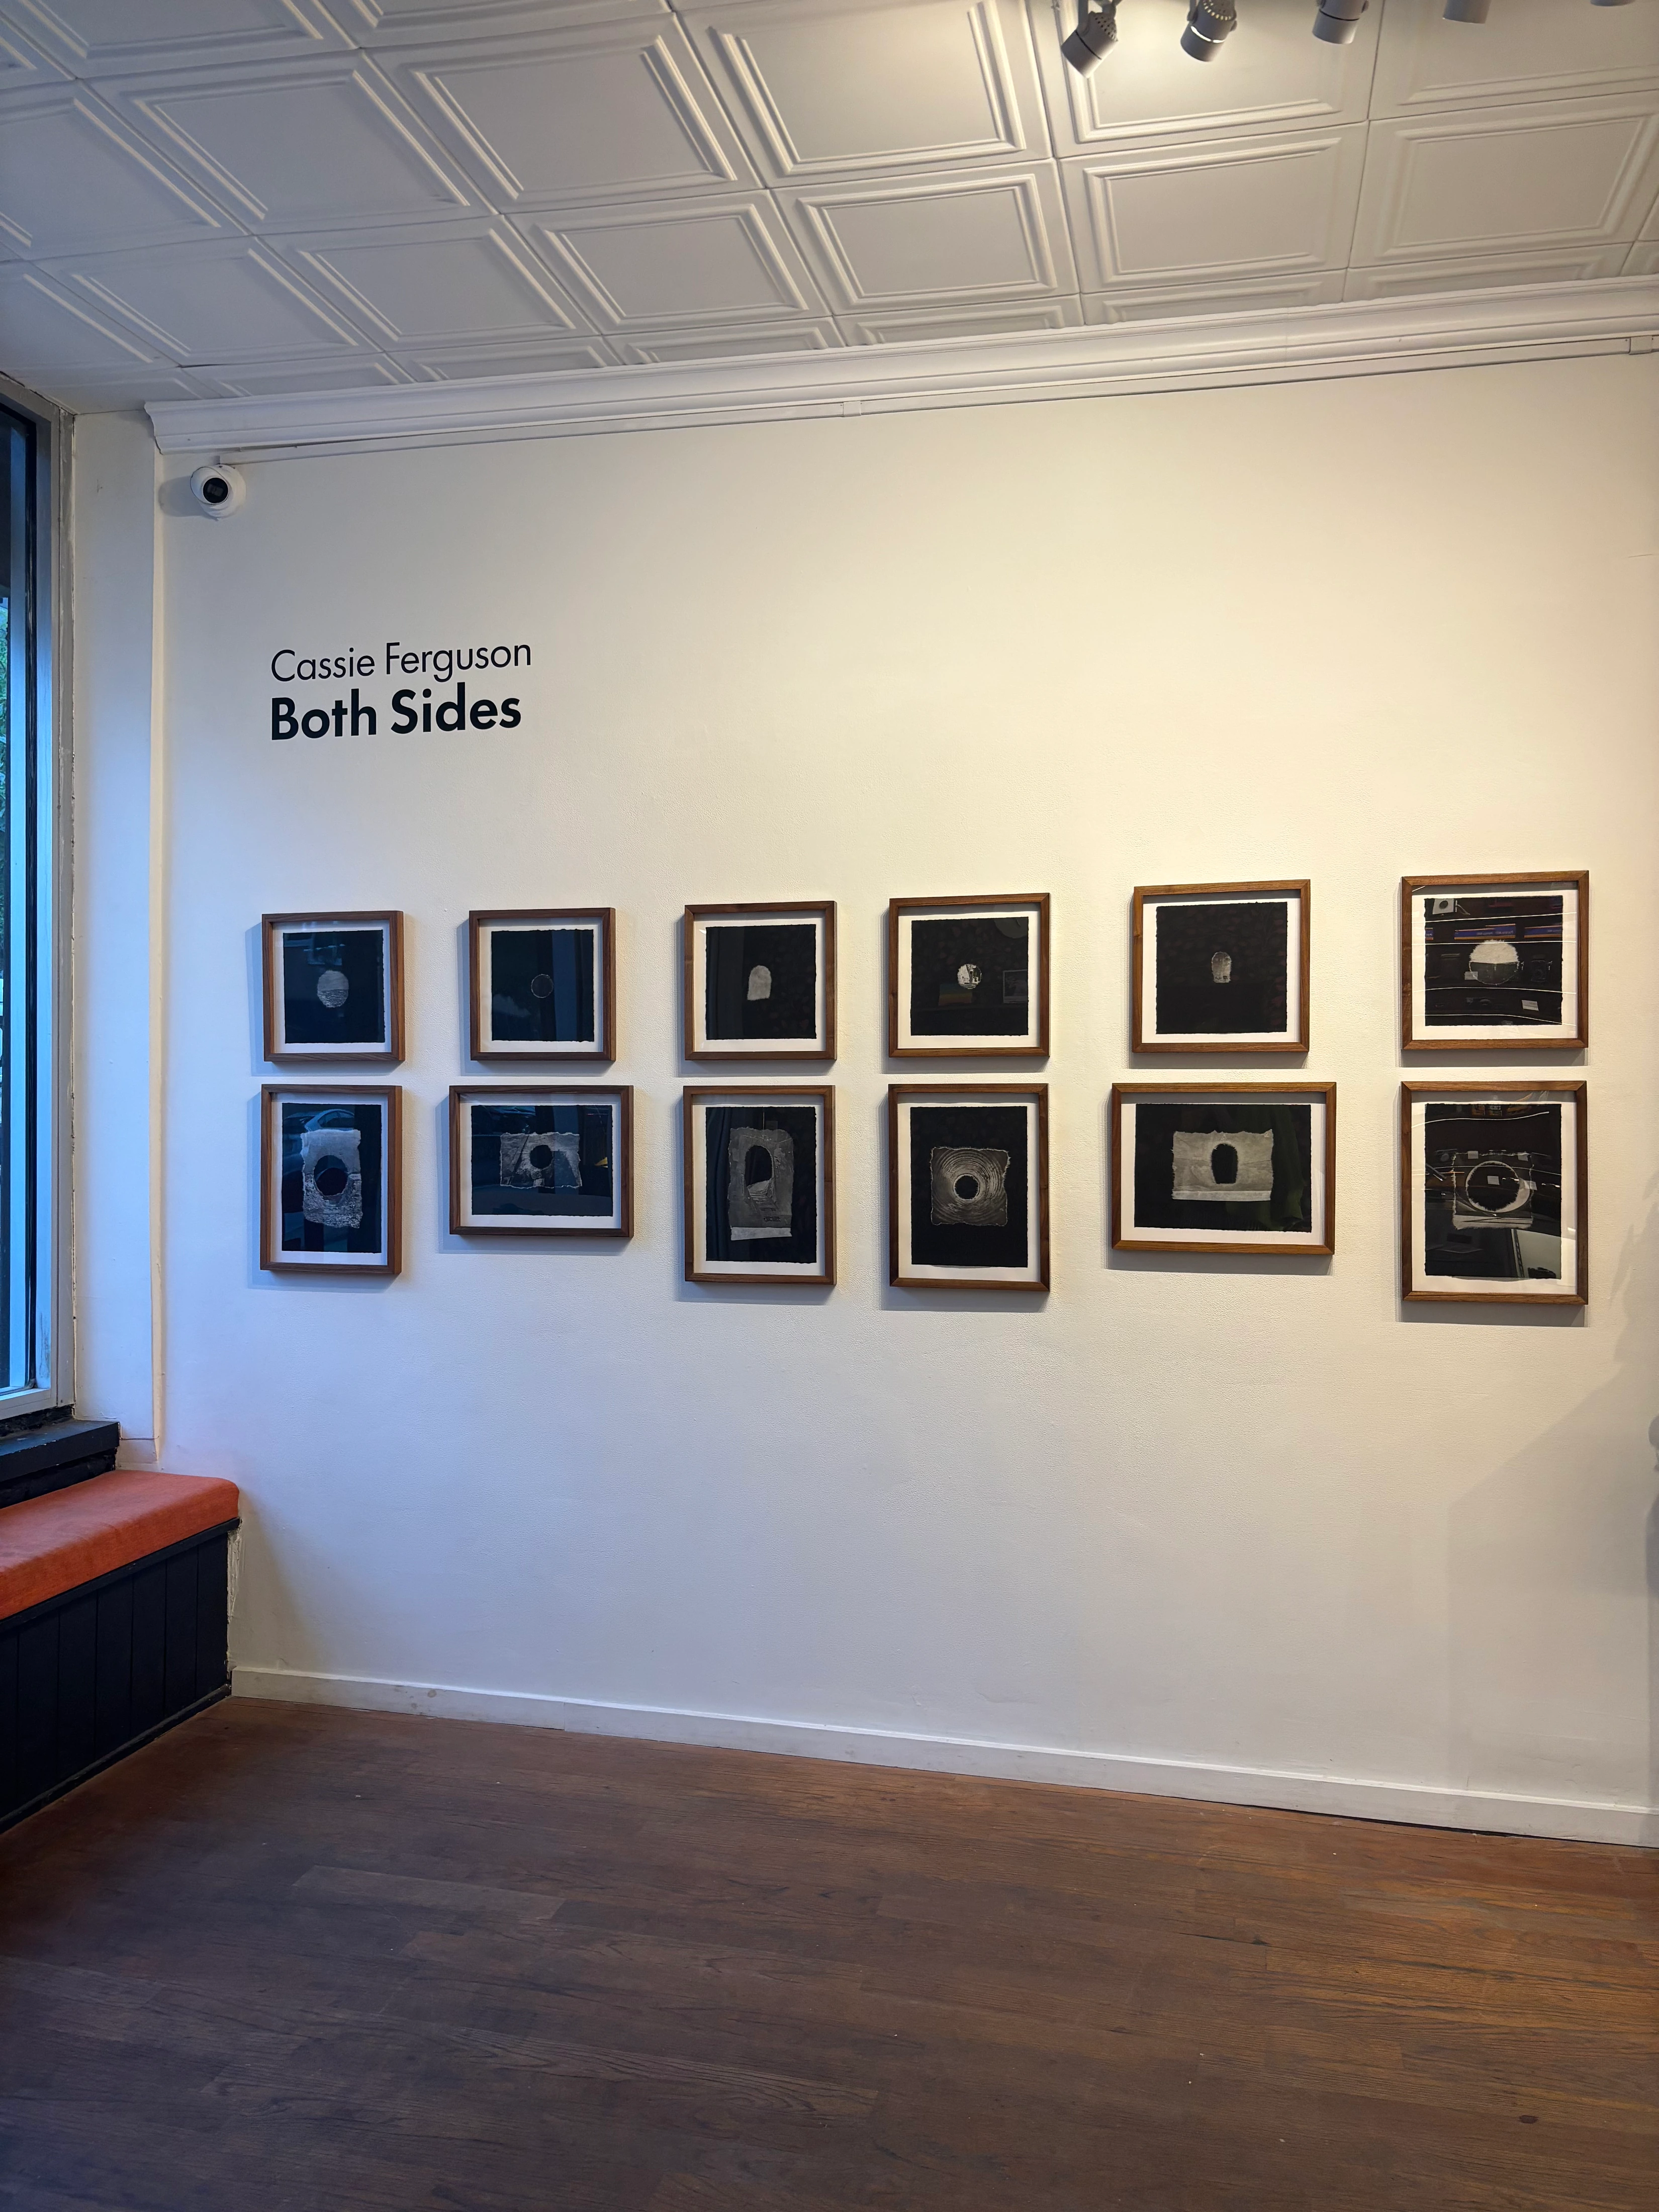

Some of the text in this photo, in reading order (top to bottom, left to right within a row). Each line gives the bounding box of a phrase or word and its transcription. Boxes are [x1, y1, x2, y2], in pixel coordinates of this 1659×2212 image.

[271, 642, 531, 682] Cassie Ferguson
[272, 682, 521, 741] Both Sides
